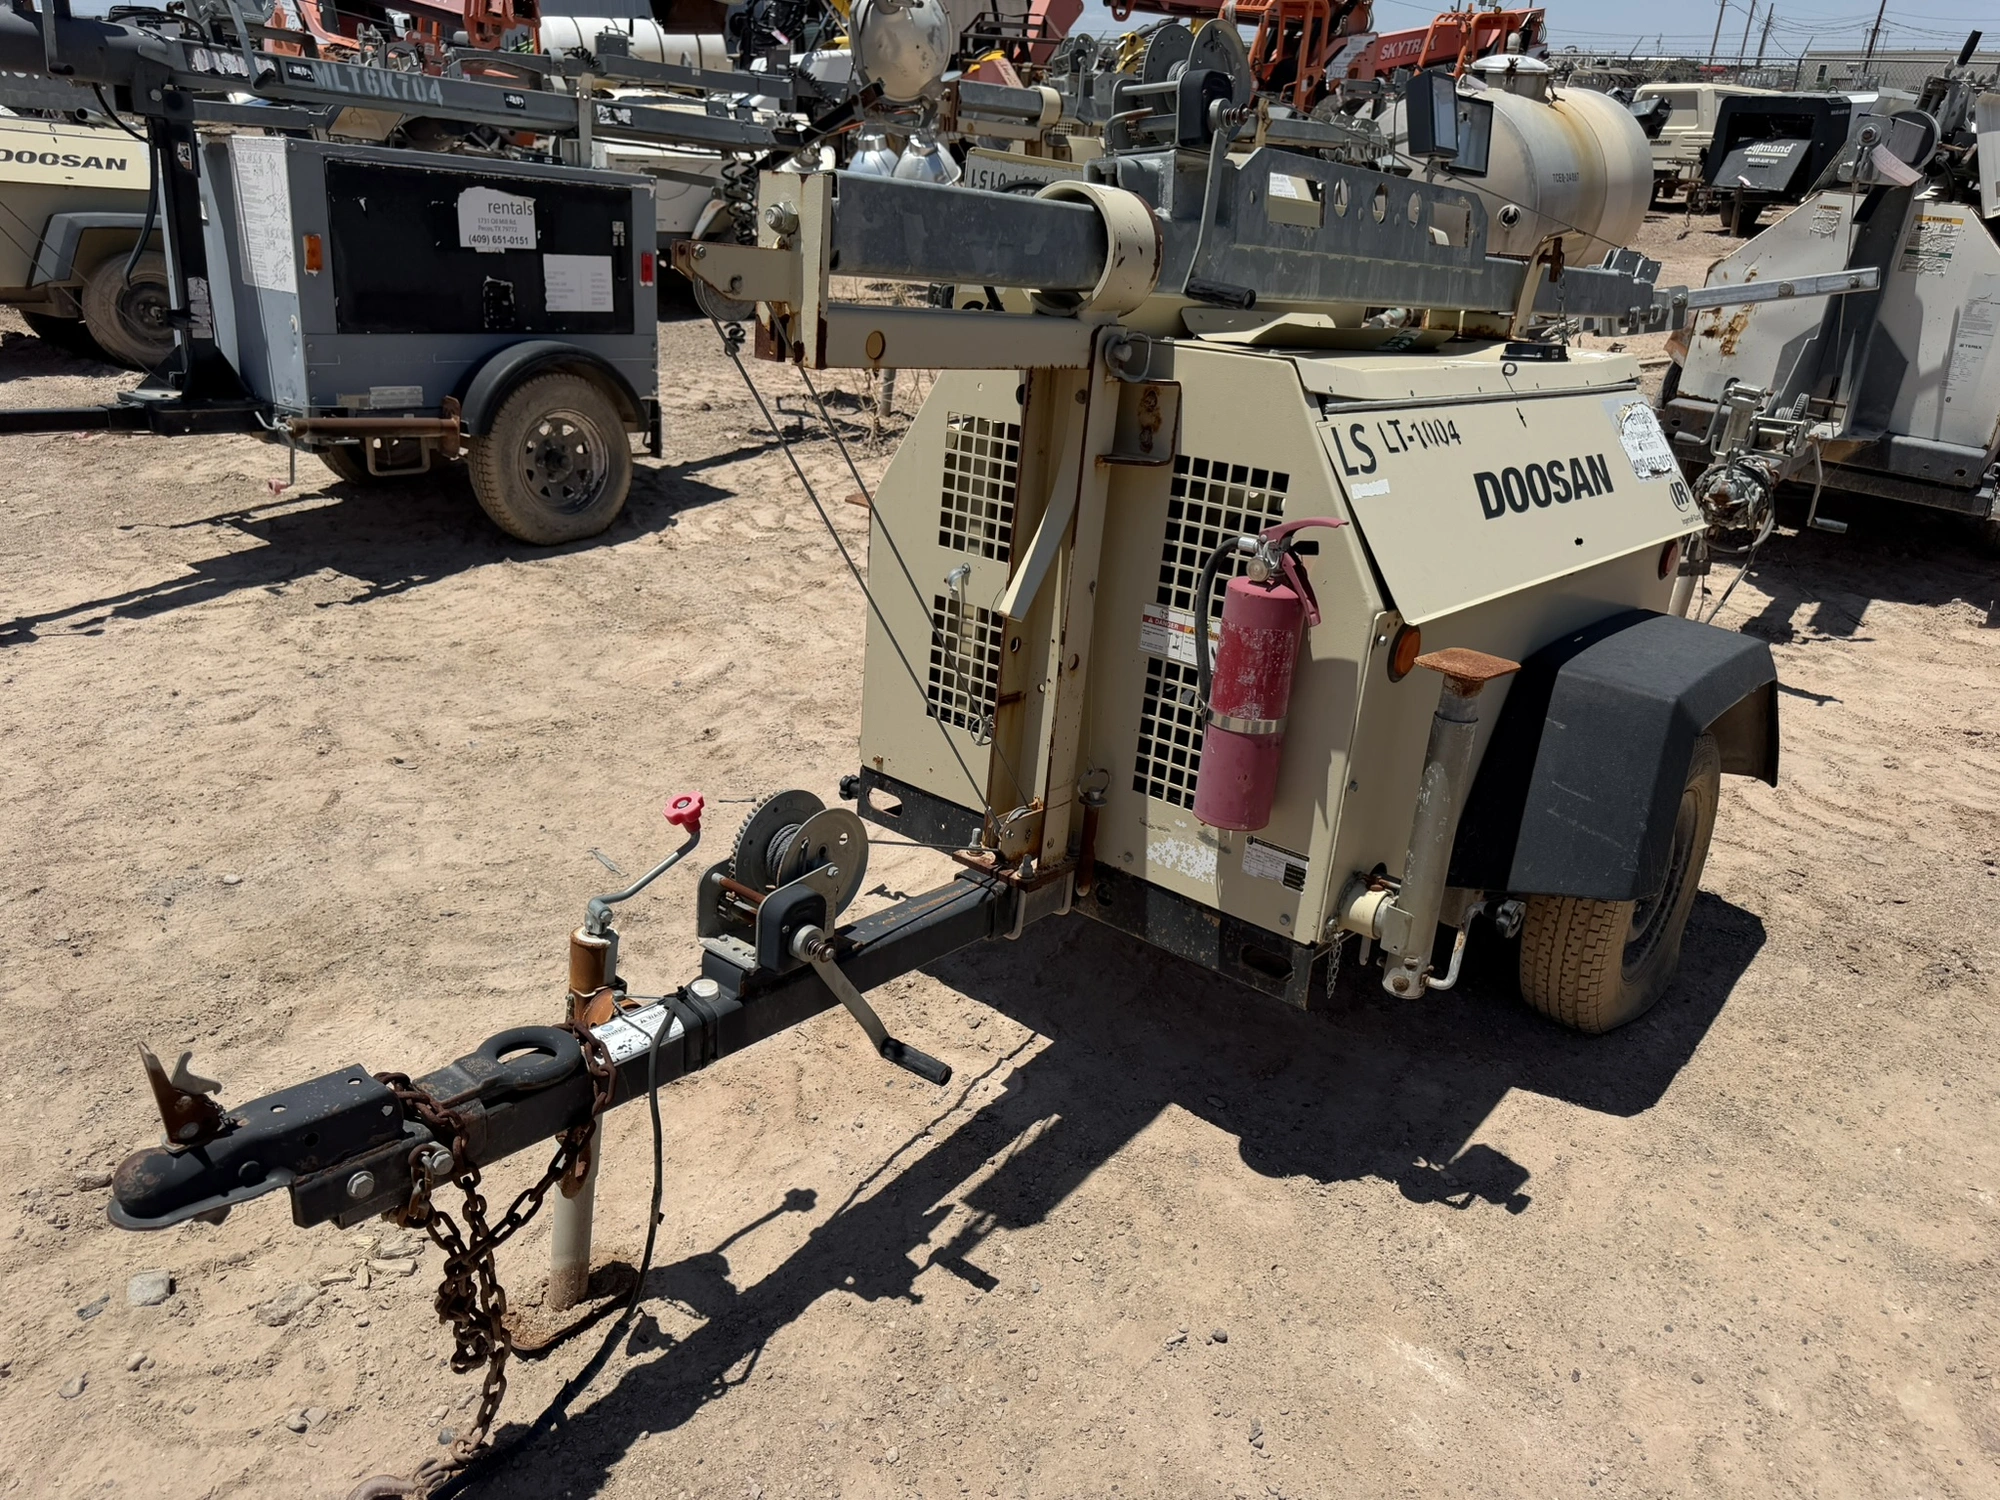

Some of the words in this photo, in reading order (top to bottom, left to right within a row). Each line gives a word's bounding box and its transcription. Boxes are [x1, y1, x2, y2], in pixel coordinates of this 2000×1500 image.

[488, 200, 533, 216] rentals
[468, 234, 490, 245] (409)
[491, 235, 529, 245] 651-0151
[1330, 423, 1377, 477] LS
[1472, 453, 1615, 520] DOOSAN
[1670, 481, 1690, 506] IR
[1154, 617, 1179, 630] DANGER
